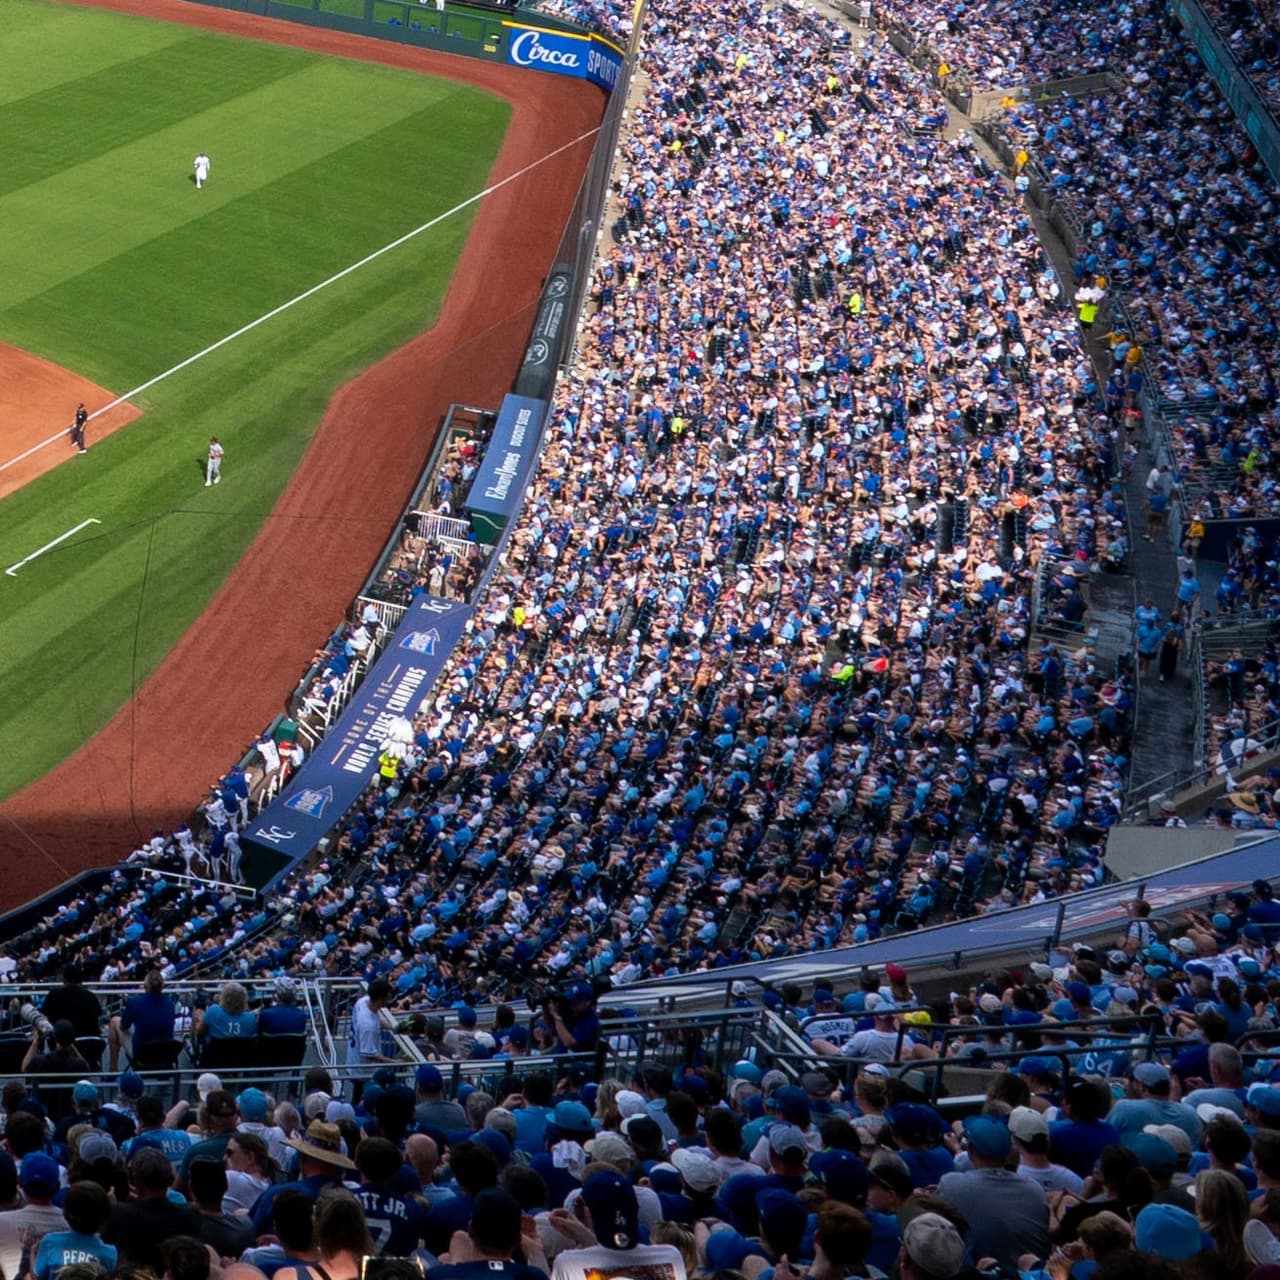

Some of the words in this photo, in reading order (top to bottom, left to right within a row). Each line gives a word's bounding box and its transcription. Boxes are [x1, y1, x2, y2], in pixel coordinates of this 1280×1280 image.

[511, 30, 580, 68] Circa
[343, 719, 369, 745] HOME
[362, 701, 379, 716] OF
[374, 679, 393, 700] THE
[343, 739, 378, 774] WORLD
[385, 666, 428, 714] CHAMPIONS
[255, 825, 296, 844] KC
[227, 1021, 240, 1036] 13
